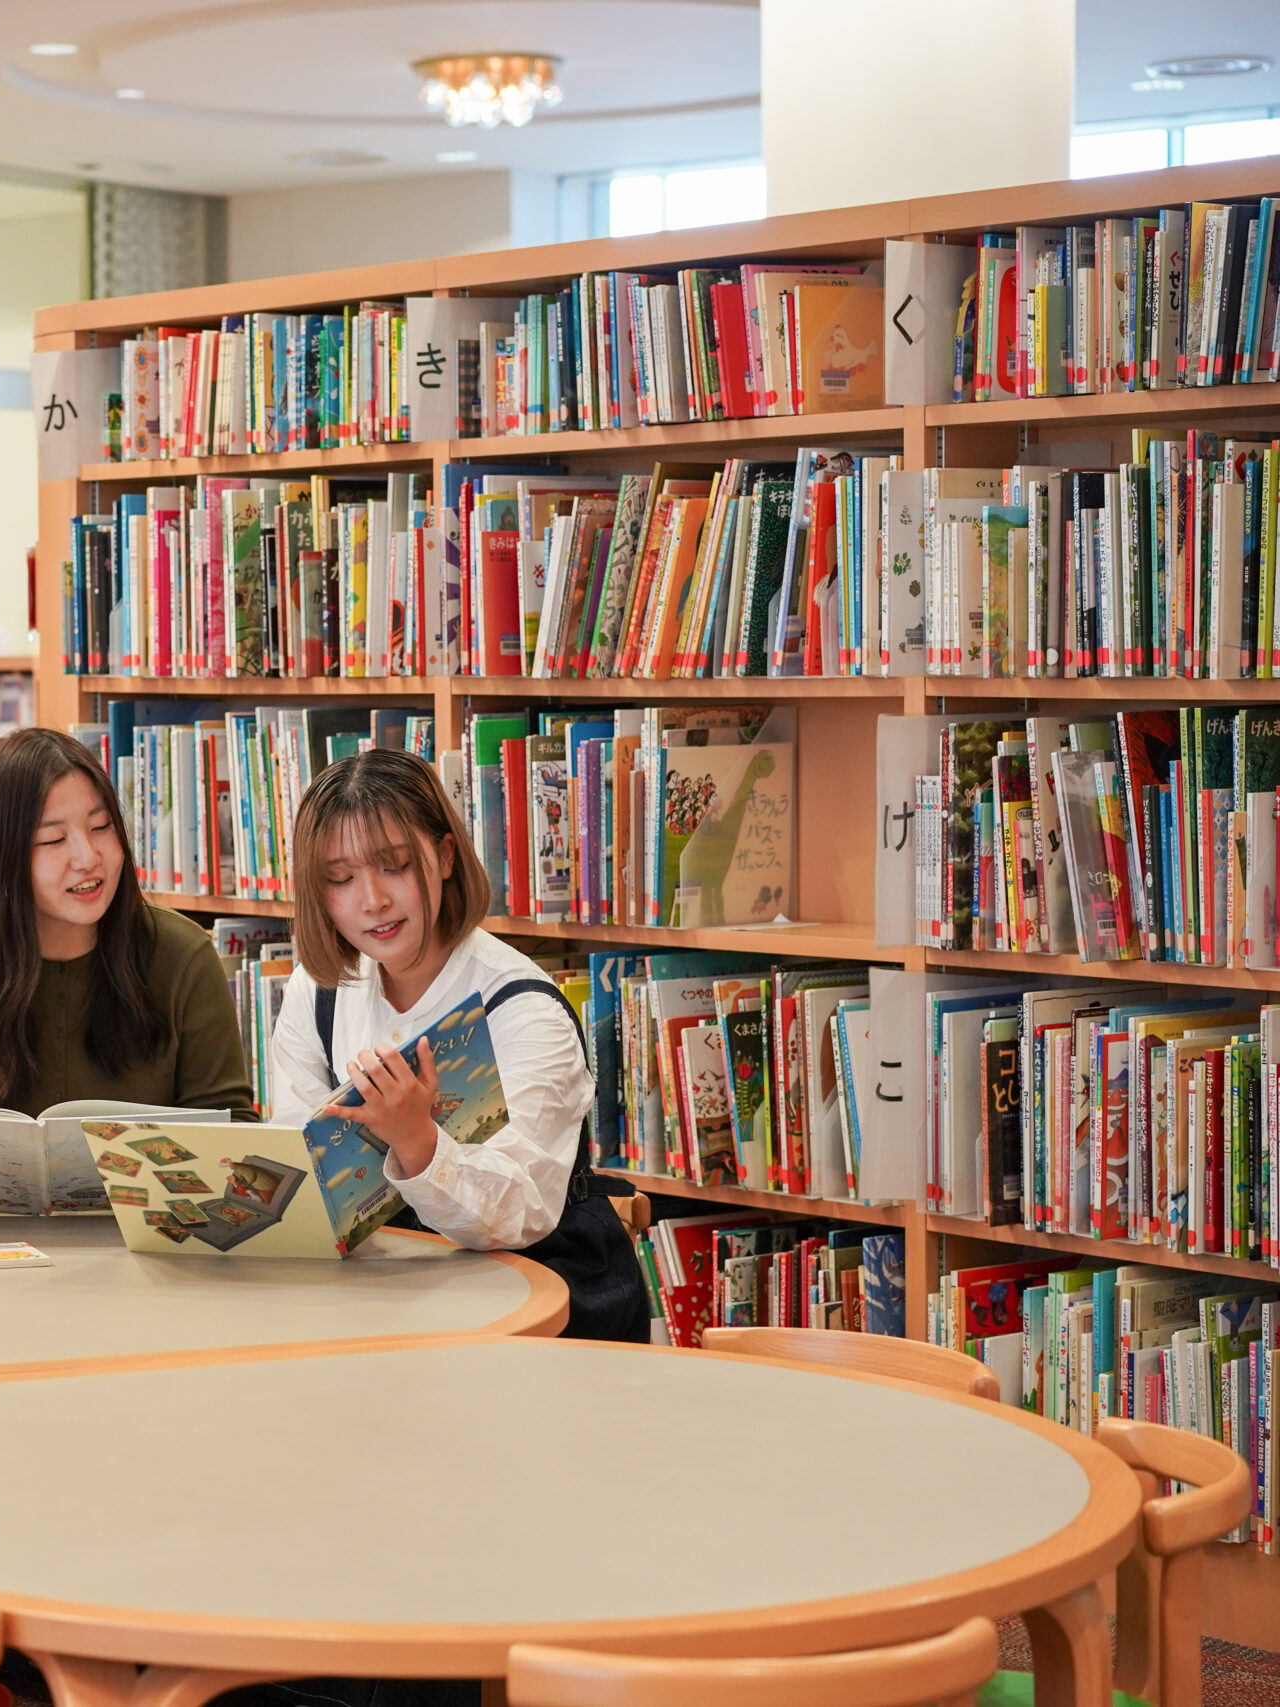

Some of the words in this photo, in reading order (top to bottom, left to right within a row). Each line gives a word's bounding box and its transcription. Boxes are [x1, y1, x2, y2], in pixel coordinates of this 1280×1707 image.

[892, 293, 914, 345] く
[415, 343, 447, 389] き
[43, 393, 79, 432] か
[883, 801, 915, 852] け
[681, 988, 714, 1001] くつやの
[875, 1060, 903, 1102] こ
[1206, 1062, 1214, 1094] ここから
